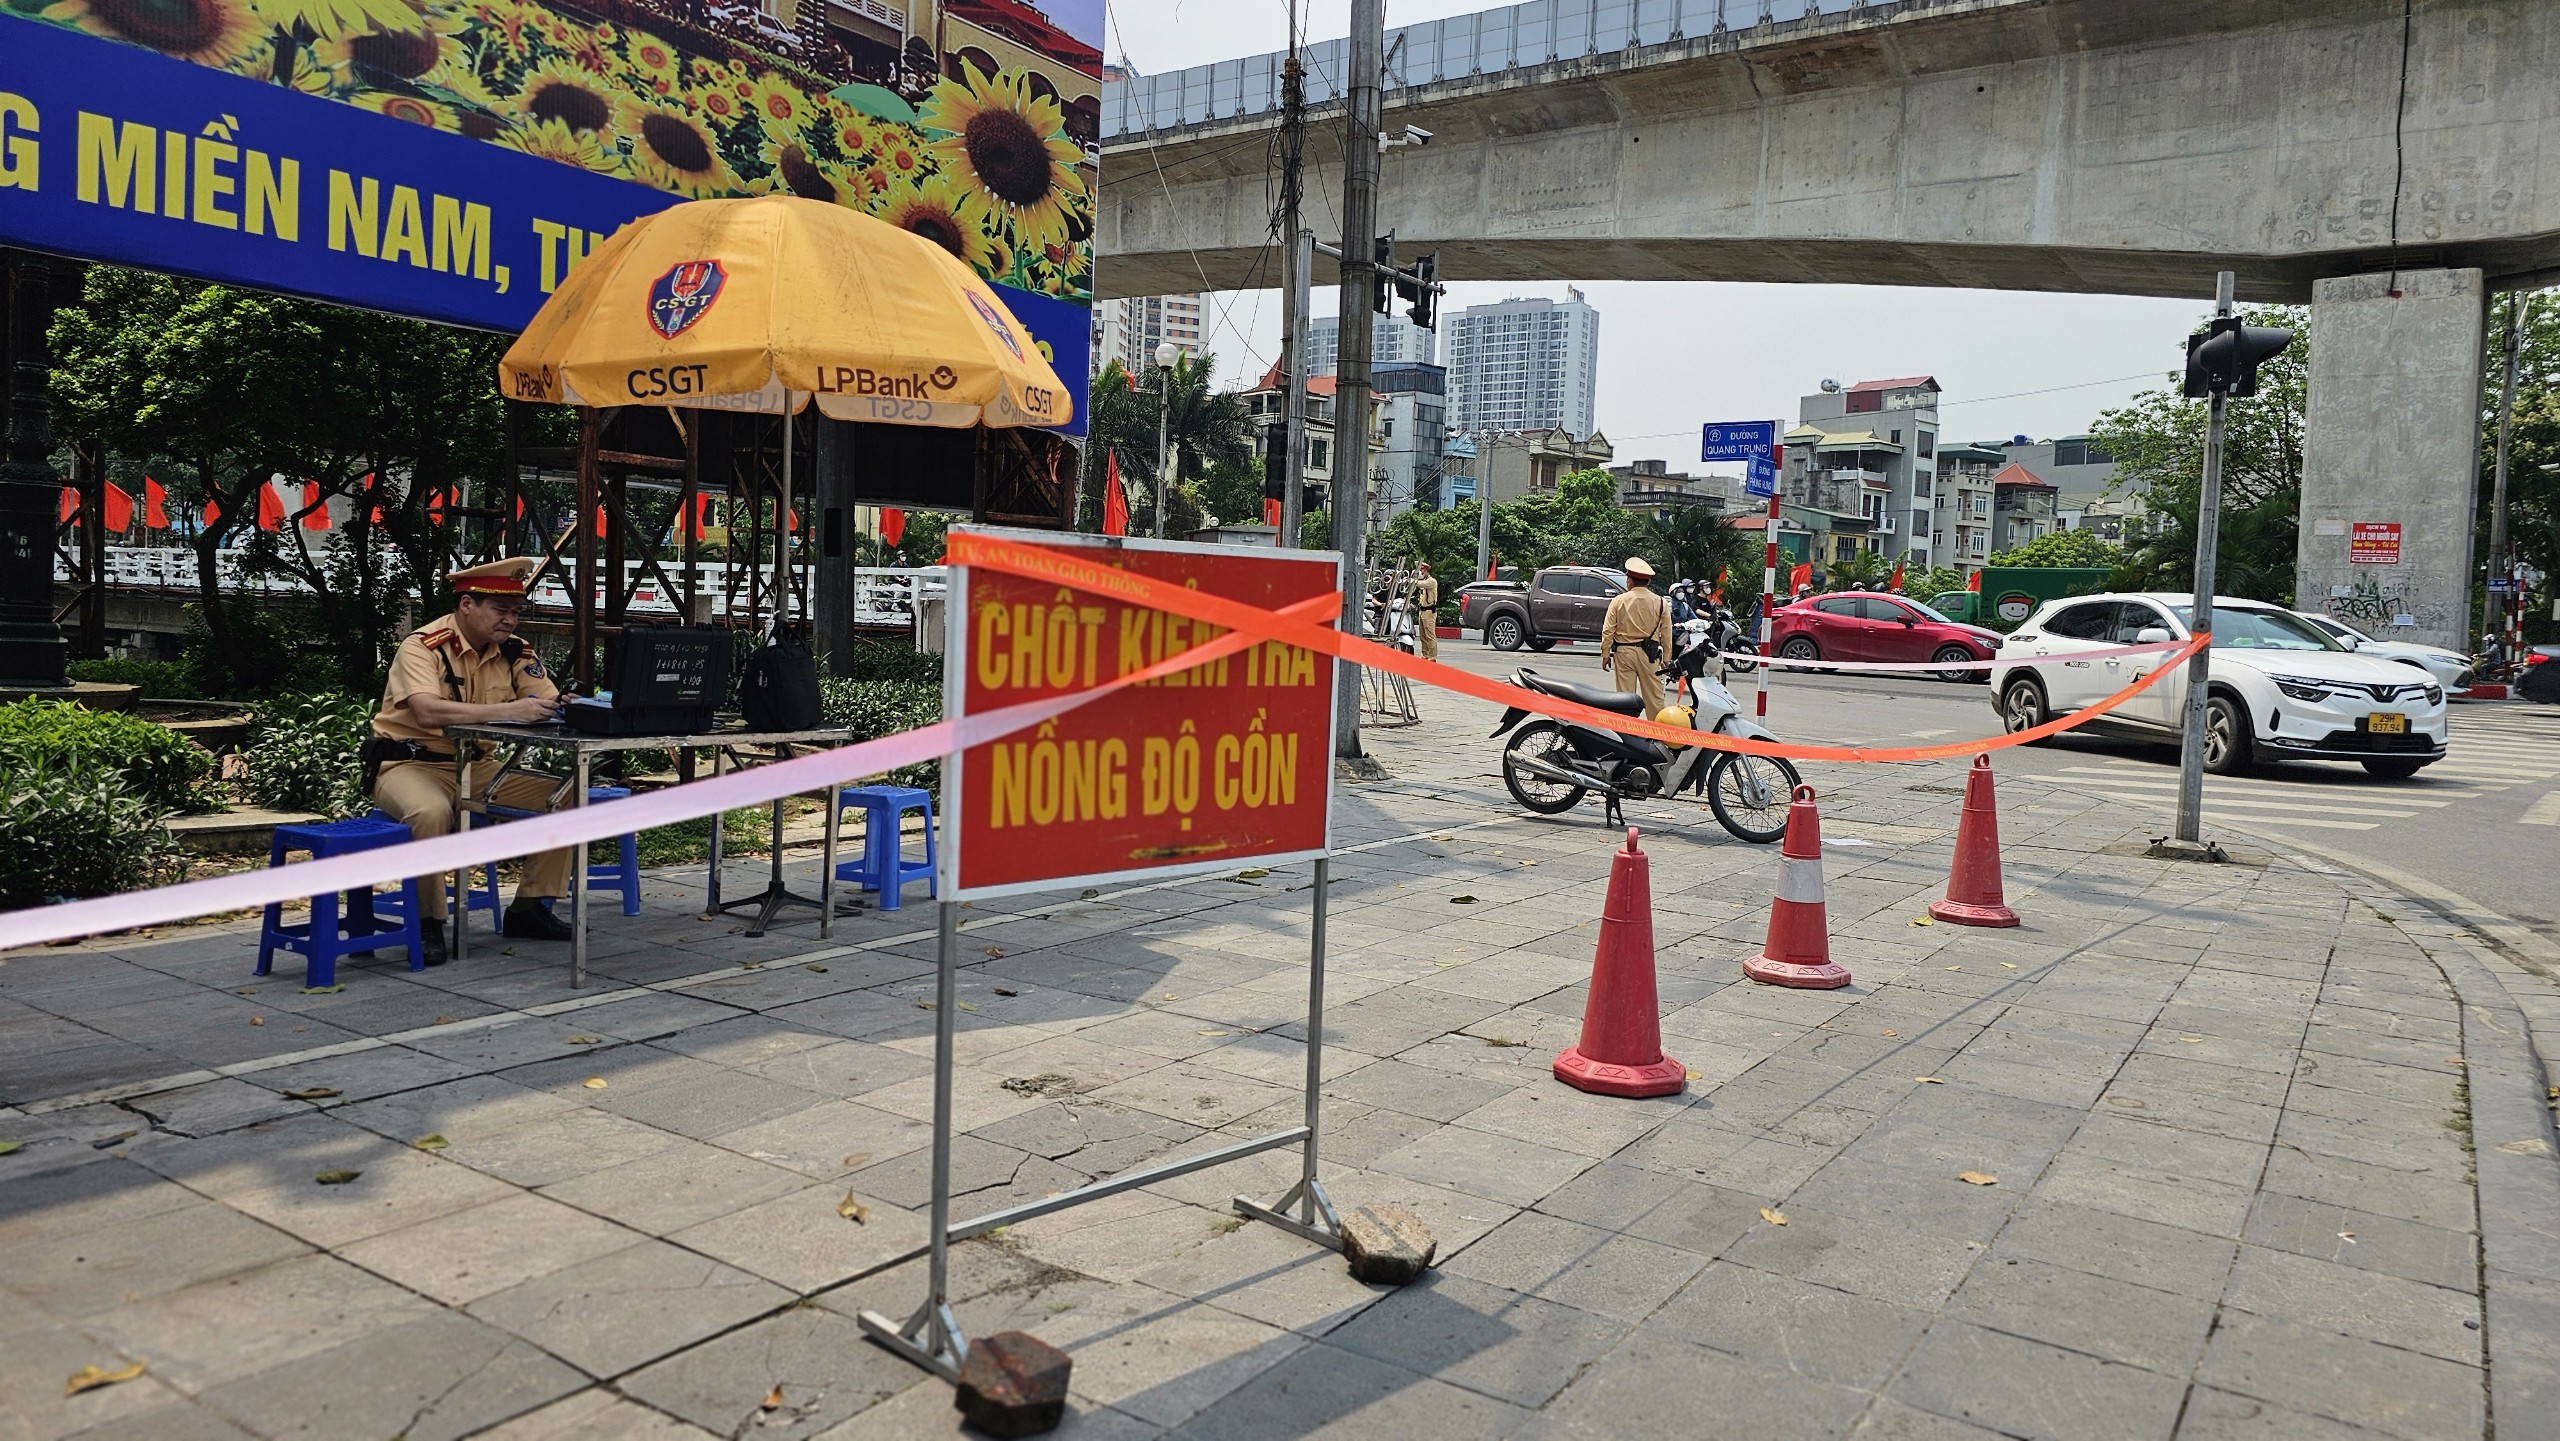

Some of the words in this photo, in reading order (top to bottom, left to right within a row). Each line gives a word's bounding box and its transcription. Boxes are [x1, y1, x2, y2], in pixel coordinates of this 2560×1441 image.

[76, 111, 300, 243] MIỀN
[327, 168, 511, 294] NAM,
[655, 294, 711, 311] CSGT
[515, 371, 547, 400] LPBank
[626, 363, 708, 399] CSGT
[817, 366, 930, 401] LPBank
[1025, 385, 1053, 416] CSGT
[1707, 445, 1737, 455] QUANG
[1738, 444, 1768, 454] TRUNG
[1730, 429, 1759, 441] ĐƯỜNG
[984, 547, 1010, 564] AN
[1057, 563, 1098, 584] GIAO
[2372, 723, 2400, 732] 937.94
[2379, 714, 2395, 723] 29H
[990, 714, 1129, 829] NỒNG
[1141, 718, 1200, 831] ĐỘ
[1214, 707, 1298, 811] CỒN
